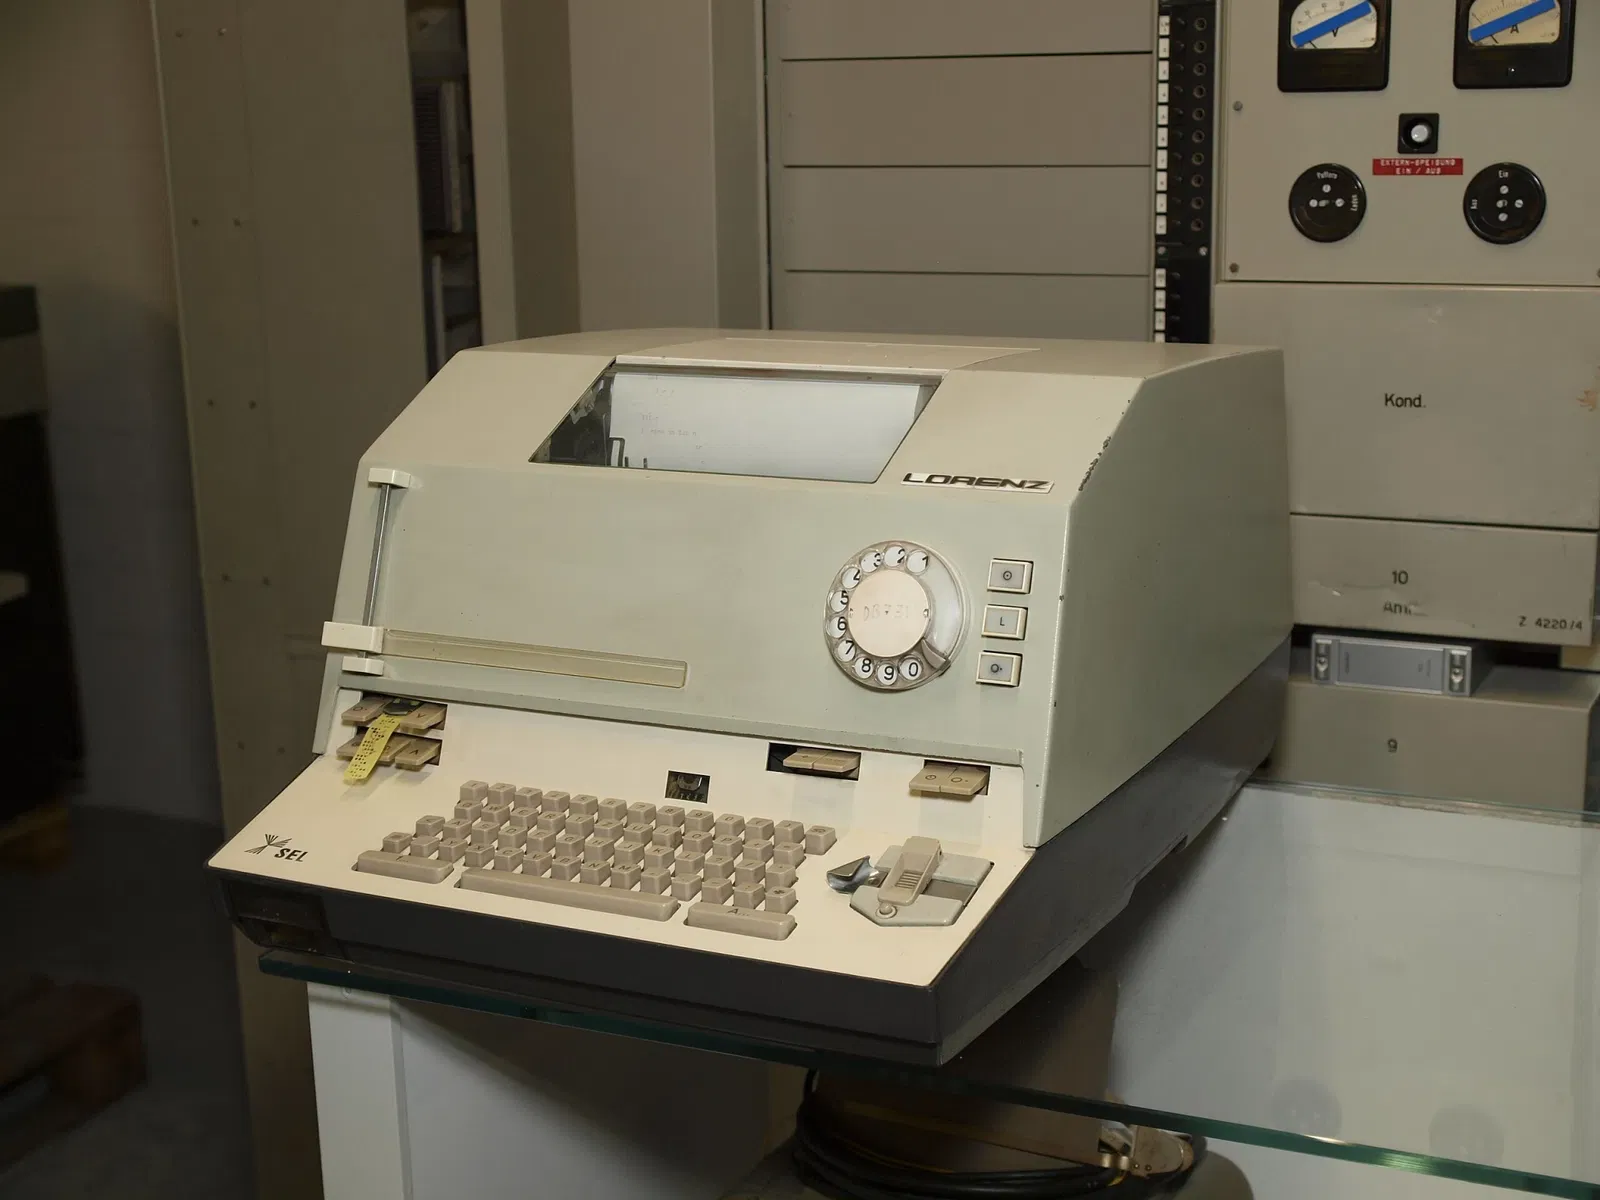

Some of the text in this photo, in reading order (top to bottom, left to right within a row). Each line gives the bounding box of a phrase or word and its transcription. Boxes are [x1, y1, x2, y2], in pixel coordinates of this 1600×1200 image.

[1384, 392, 1427, 408] Kond.
[902, 472, 1049, 490] LORENZ
[1391, 569, 1409, 585] 10
[839, 590, 850, 606] 5
[837, 616, 848, 632] 6
[999, 616, 1006, 627] L
[1518, 614, 1527, 628] Z
[845, 640, 855, 656] 7
[861, 657, 872, 673] 8
[883, 665, 895, 681] 9
[908, 661, 919, 678] 0
[274, 847, 309, 863] SEL
